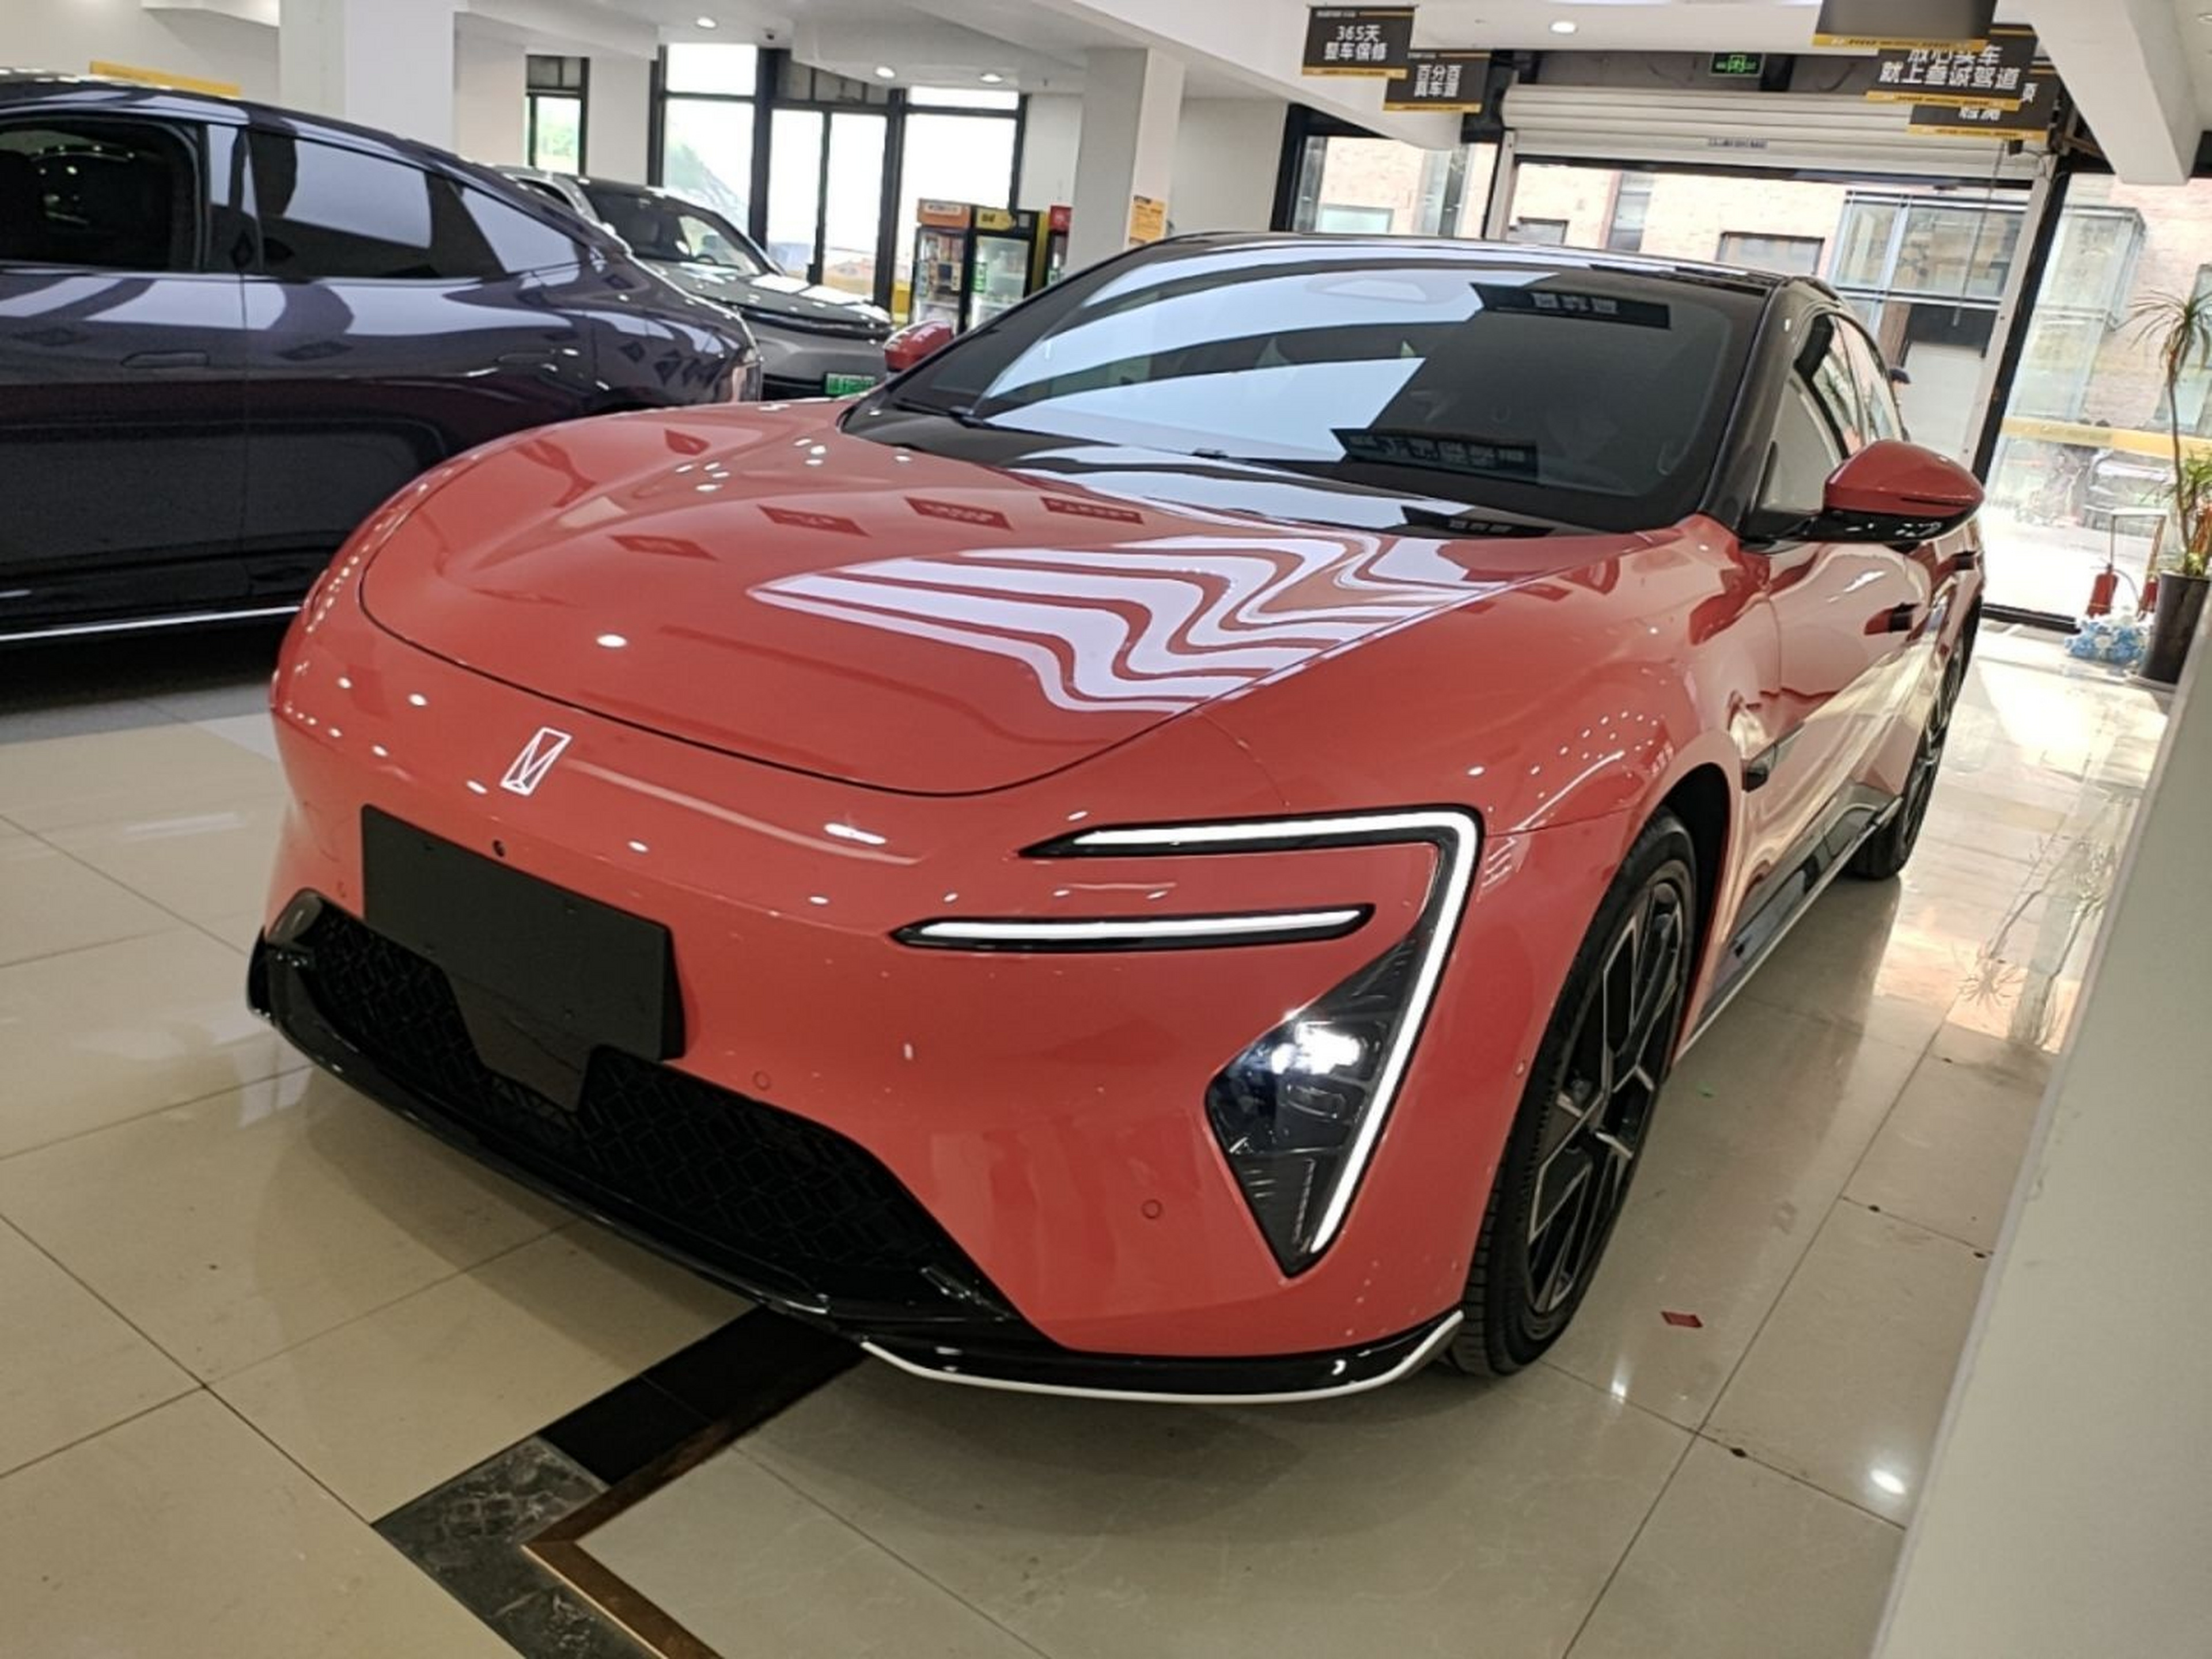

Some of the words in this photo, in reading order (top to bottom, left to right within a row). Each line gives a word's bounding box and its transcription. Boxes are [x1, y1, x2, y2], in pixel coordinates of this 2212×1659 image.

[1336, 25, 1381, 43] 365天
[1416, 64, 1463, 82] 百分百
